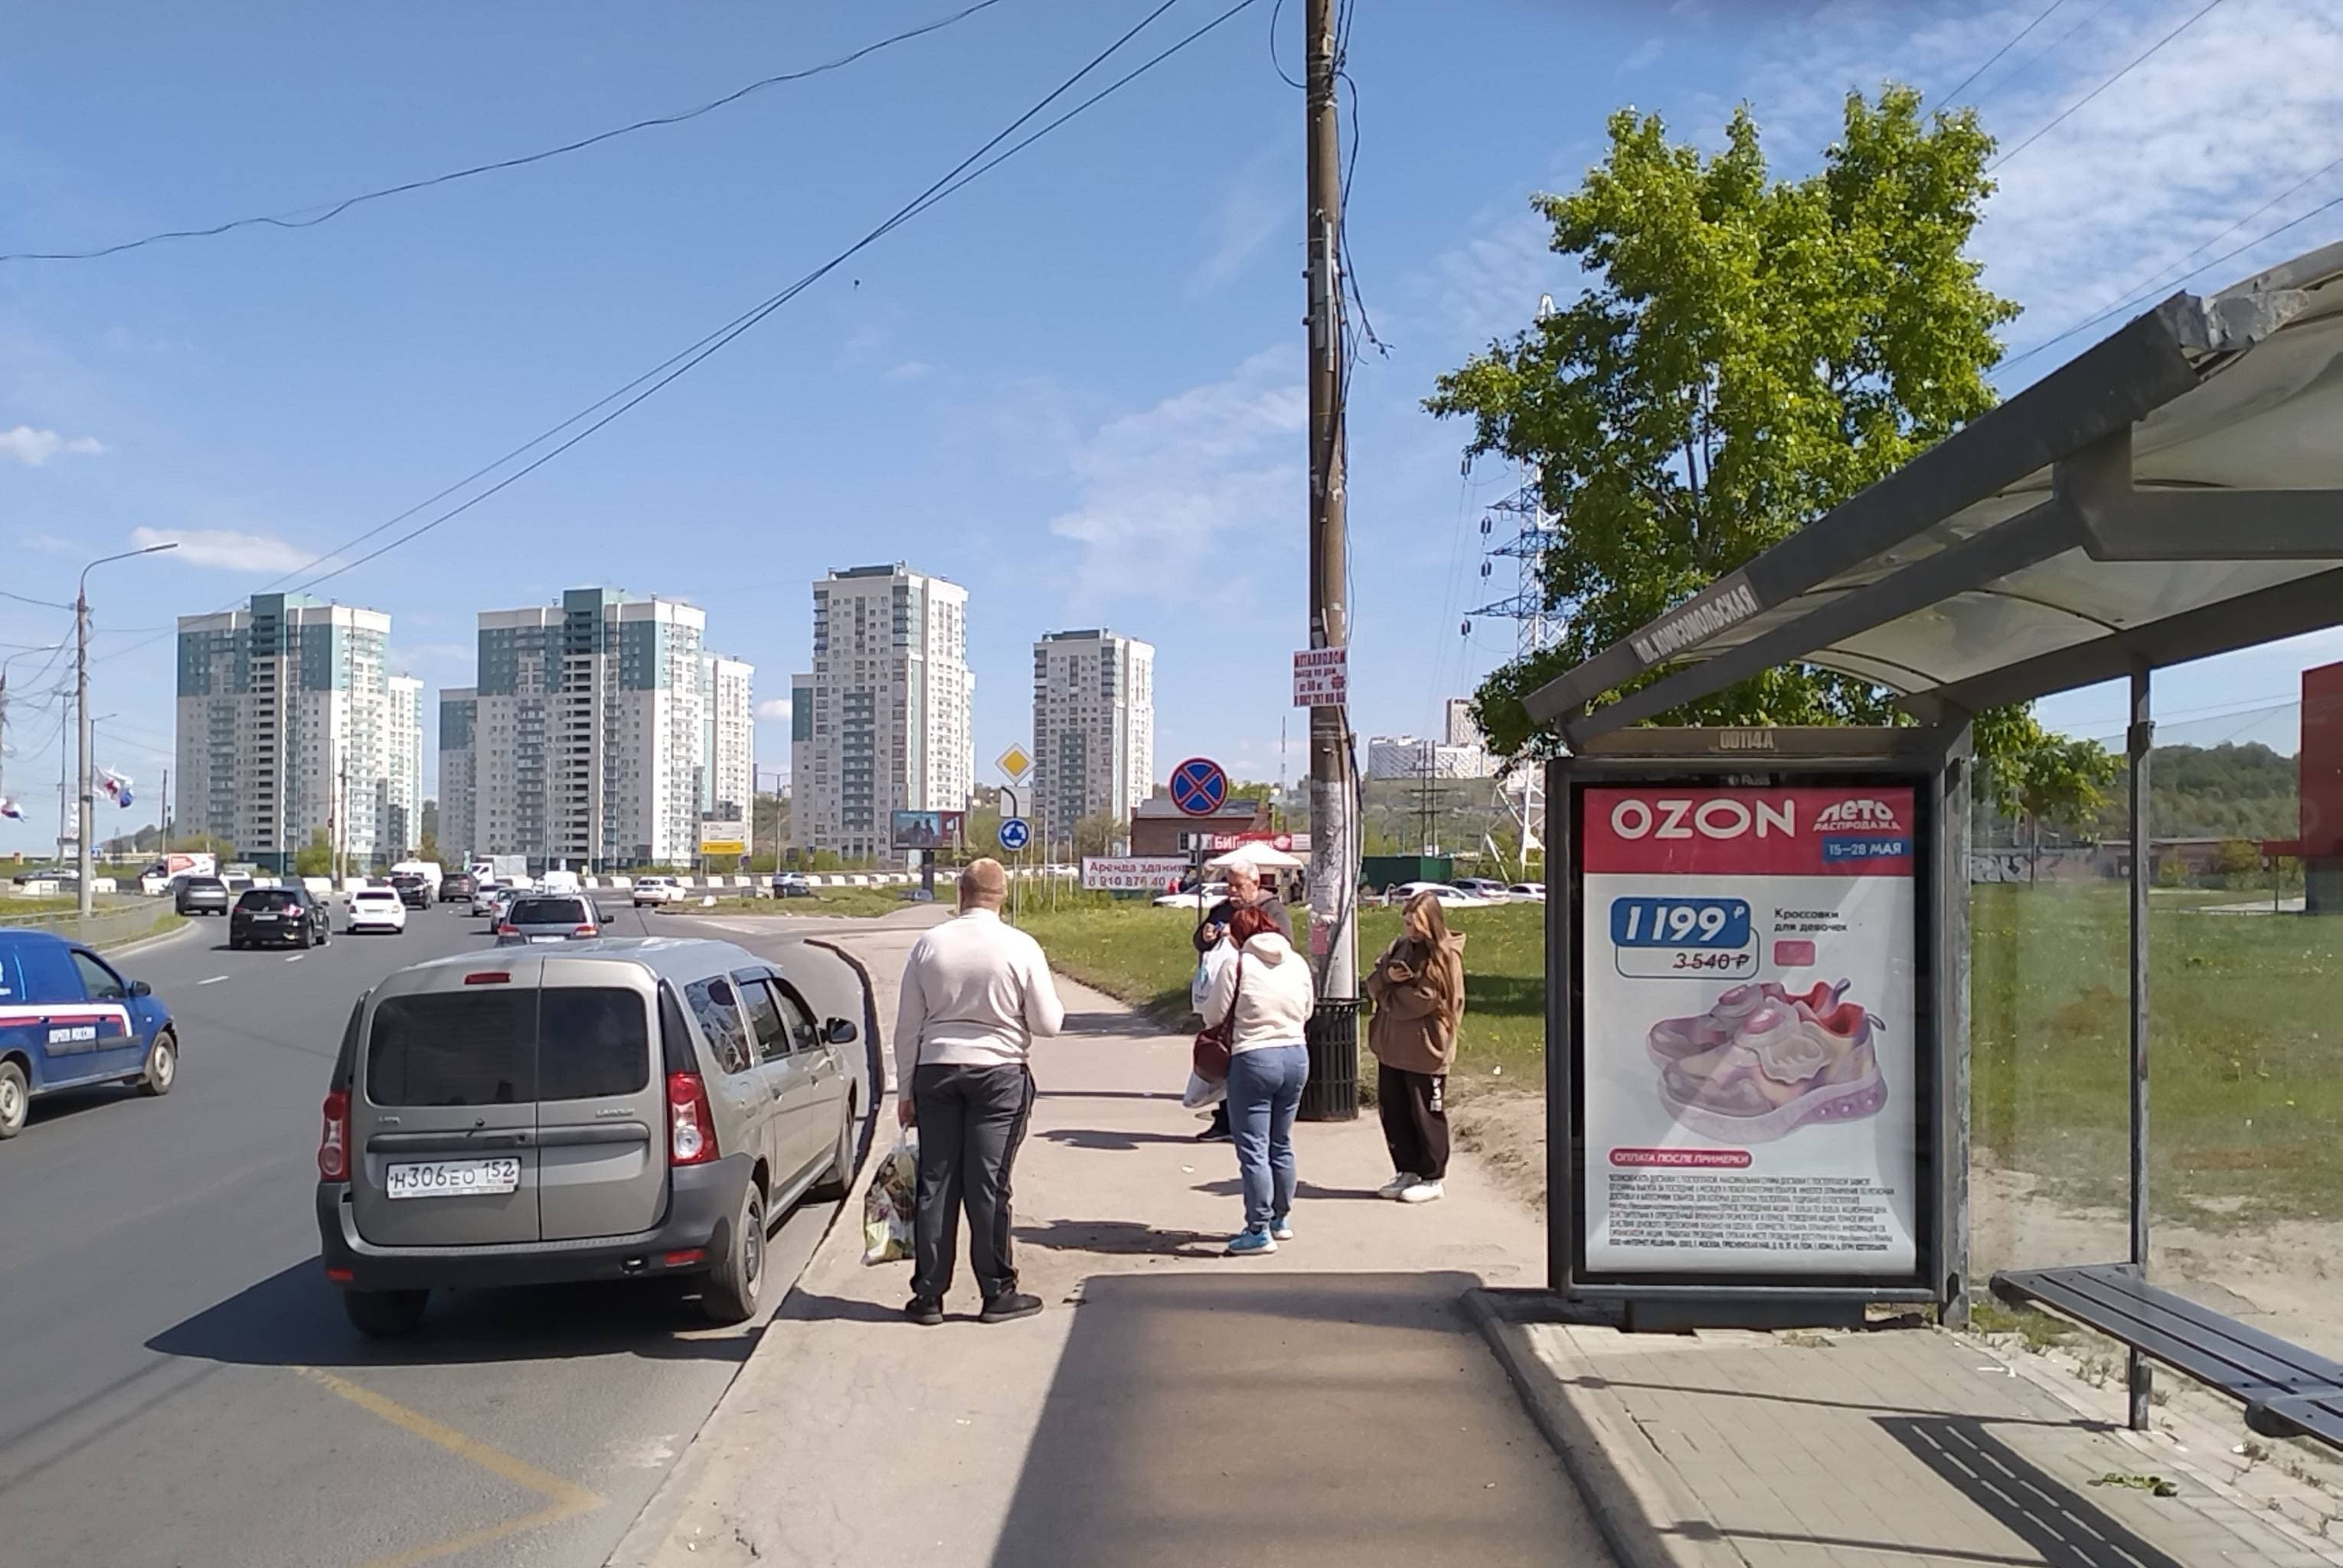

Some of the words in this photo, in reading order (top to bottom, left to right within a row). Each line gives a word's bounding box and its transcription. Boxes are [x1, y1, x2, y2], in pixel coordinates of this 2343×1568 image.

[1650, 584, 1758, 656] КОМСОМОЛЬСКАЯ
[1611, 799, 1796, 839] OZON
[1812, 821, 1901, 831] РАСПРОДАЖА
[1869, 842, 1902, 854] МАЯ
[1090, 862, 1136, 874] Аренда
[1774, 907, 1839, 920] Кроссовки
[1773, 923, 1796, 933] для
[1799, 923, 1848, 933] девочек
[1614, 1152, 1655, 1162] ОПЛАТА
